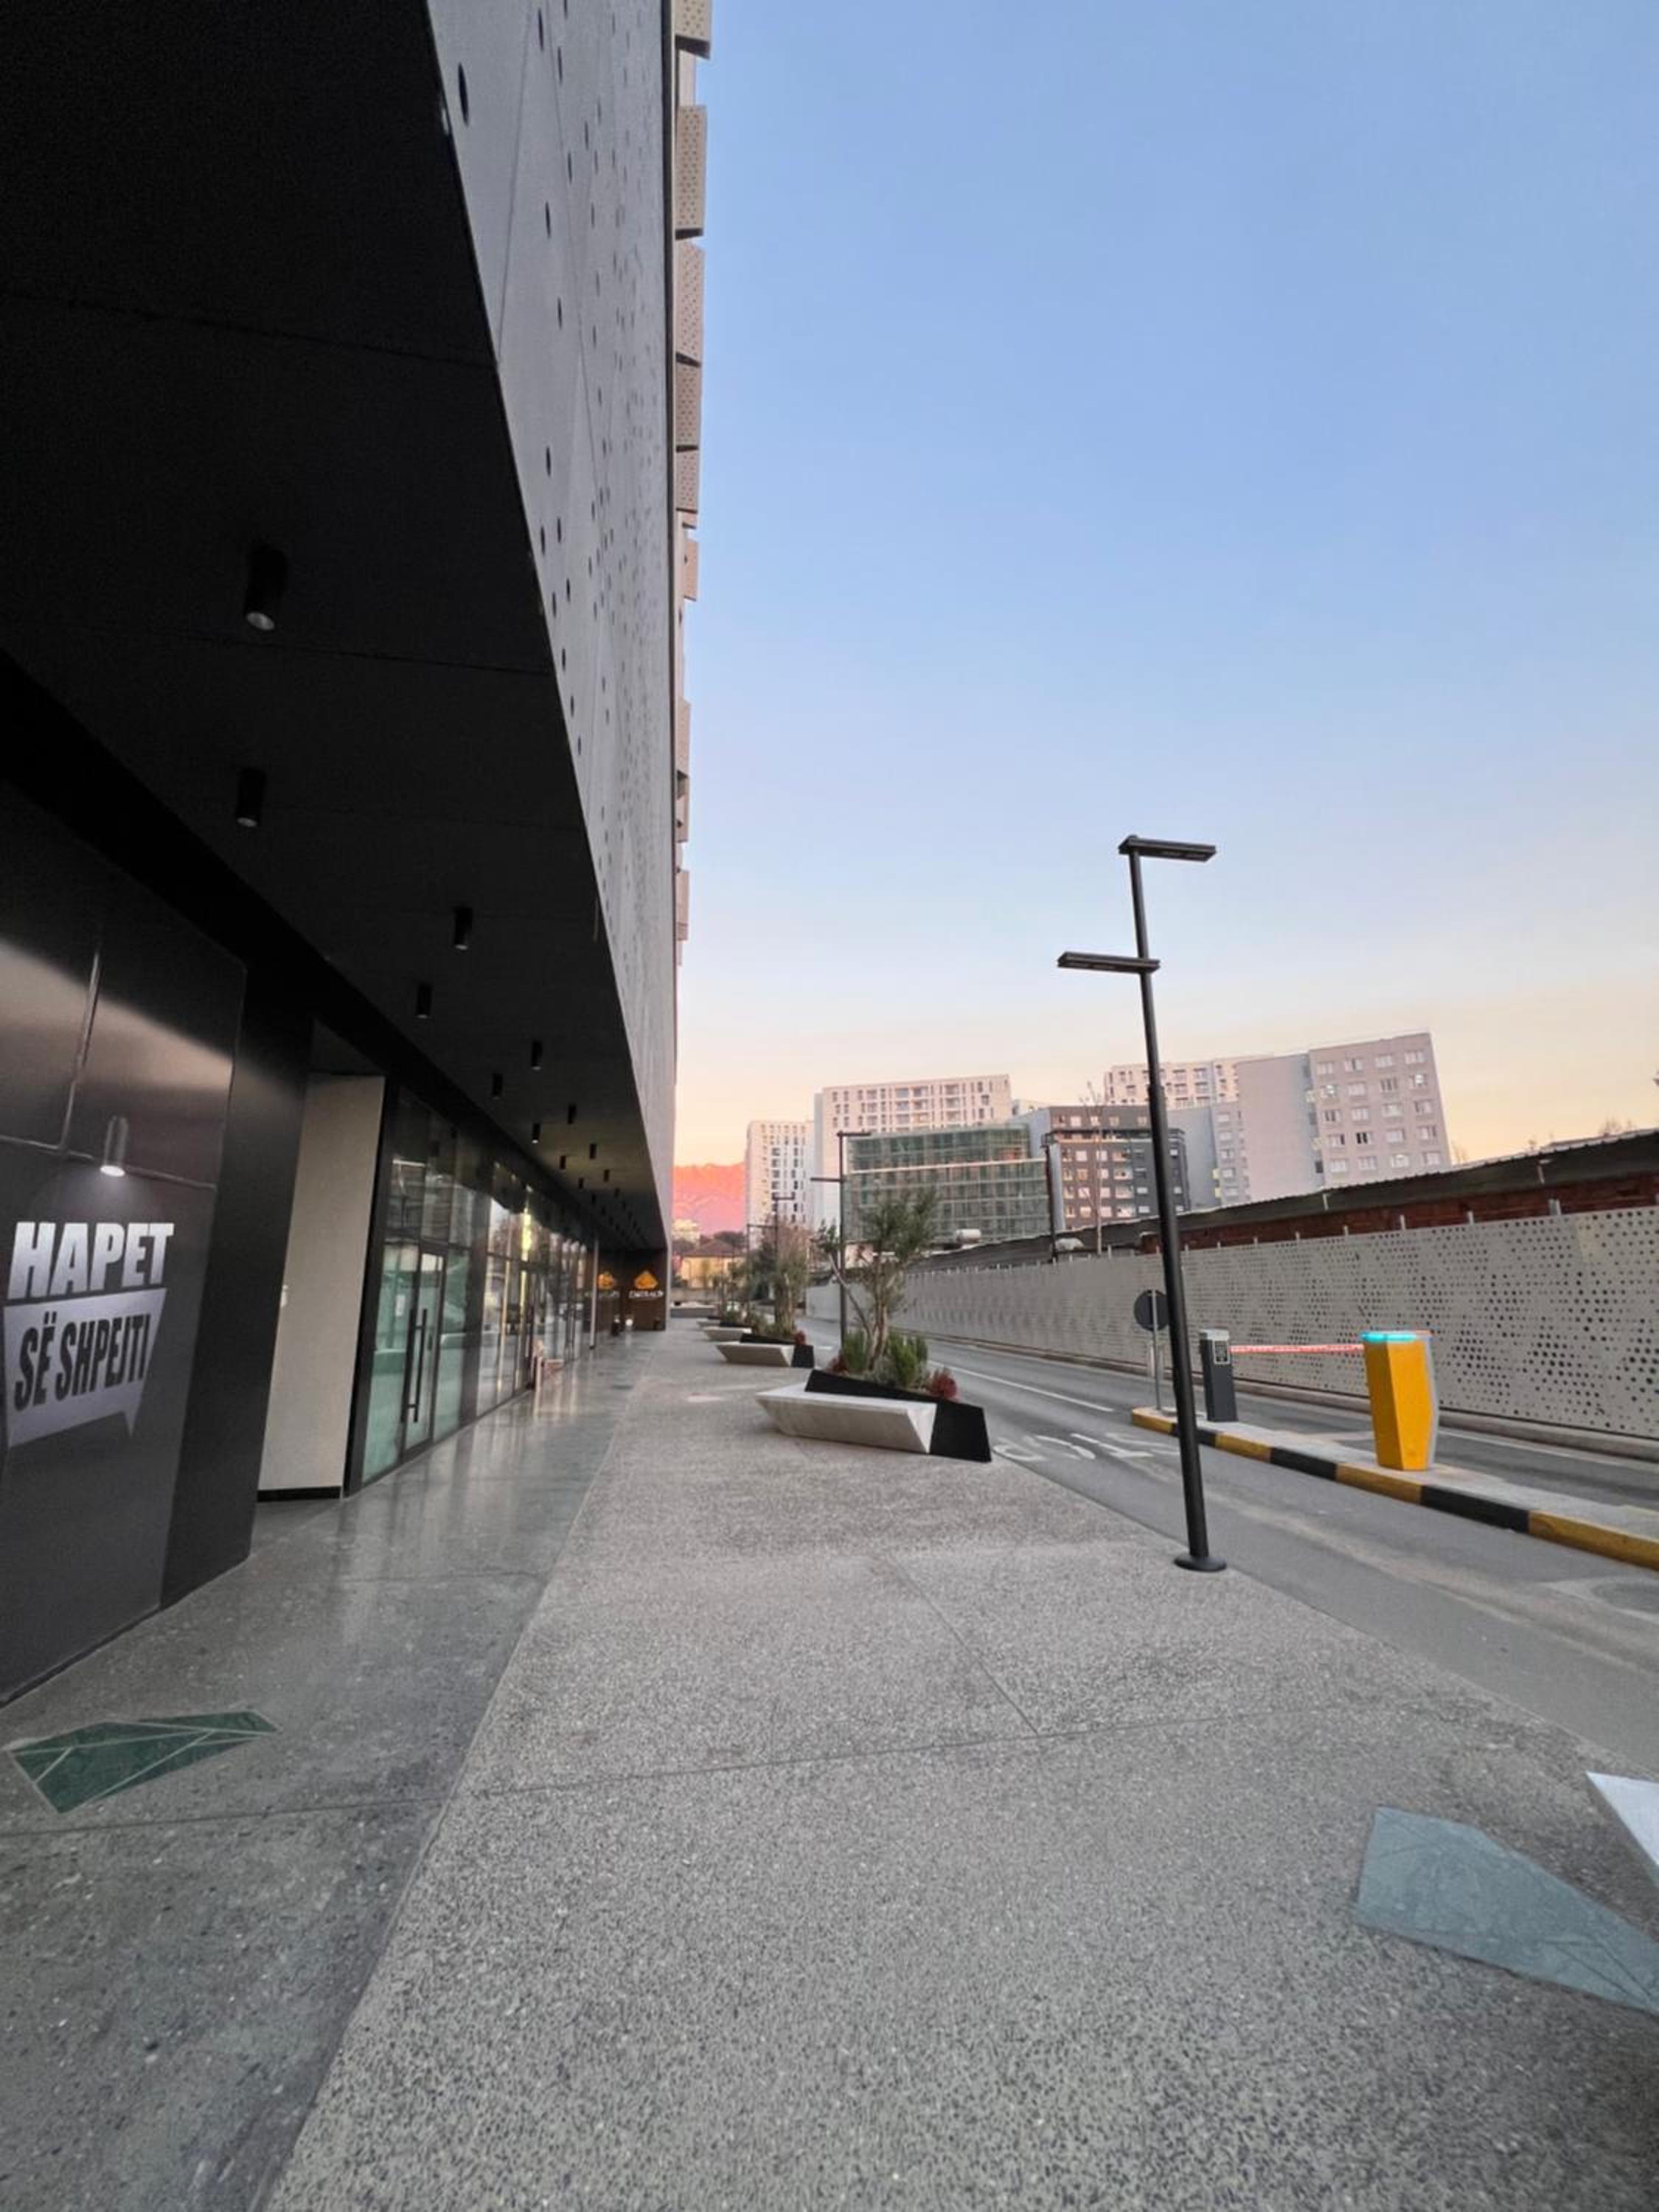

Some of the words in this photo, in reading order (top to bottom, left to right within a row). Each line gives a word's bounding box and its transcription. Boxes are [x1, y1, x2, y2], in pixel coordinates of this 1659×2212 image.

[7, 1222, 174, 1300] HAPET
[14, 1312, 57, 1411] SË
[55, 1314, 150, 1401] SHPEJTI
